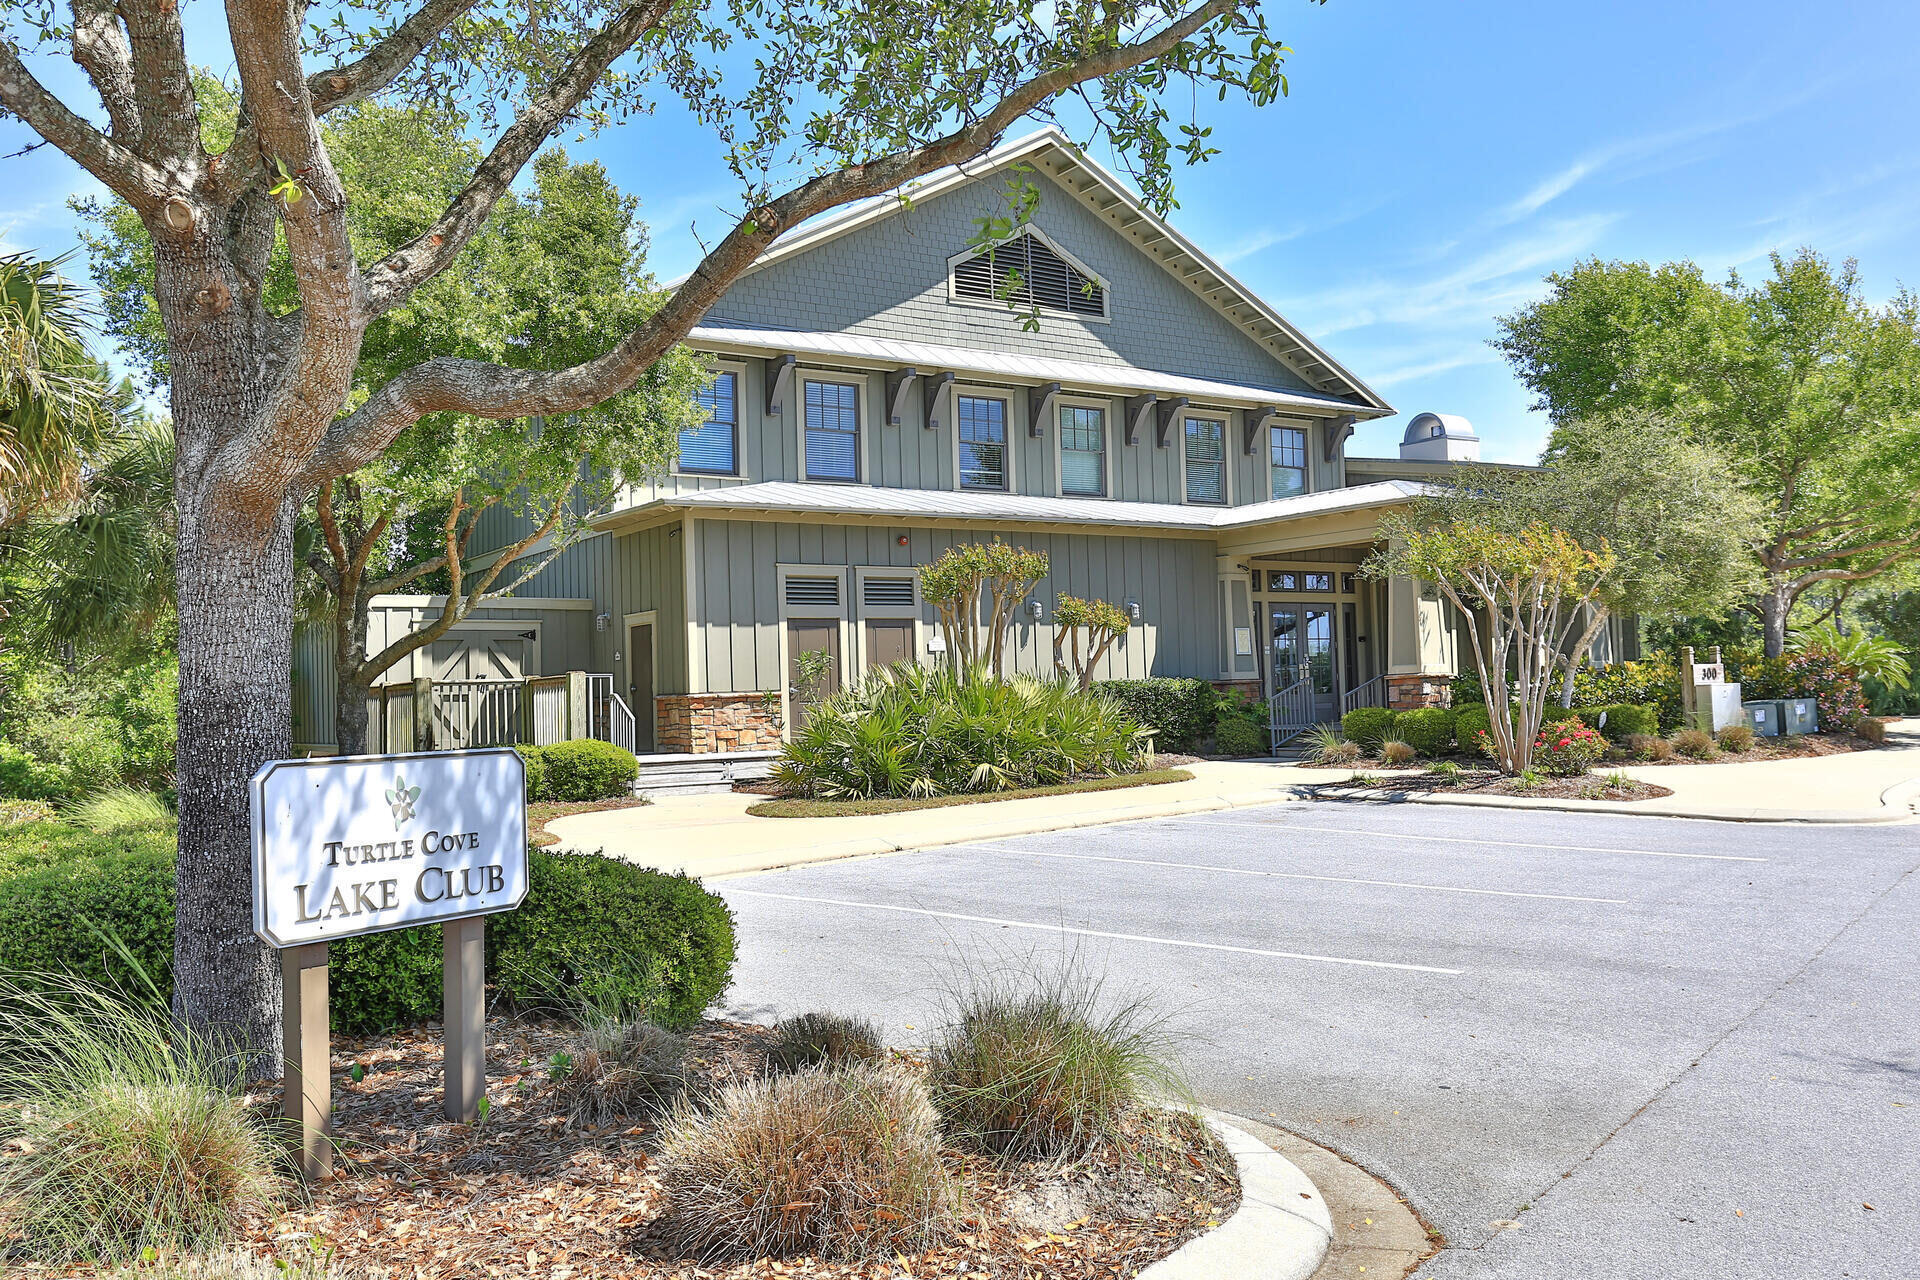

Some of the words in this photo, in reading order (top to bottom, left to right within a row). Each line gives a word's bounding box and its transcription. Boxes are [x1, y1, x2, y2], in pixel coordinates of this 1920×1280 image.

[1701, 667, 1717, 680] 300
[324, 840, 414, 867] TURTLE
[421, 831, 480, 856] COVE
[294, 879, 400, 924] LAKE
[415, 865, 505, 904] CLUB
